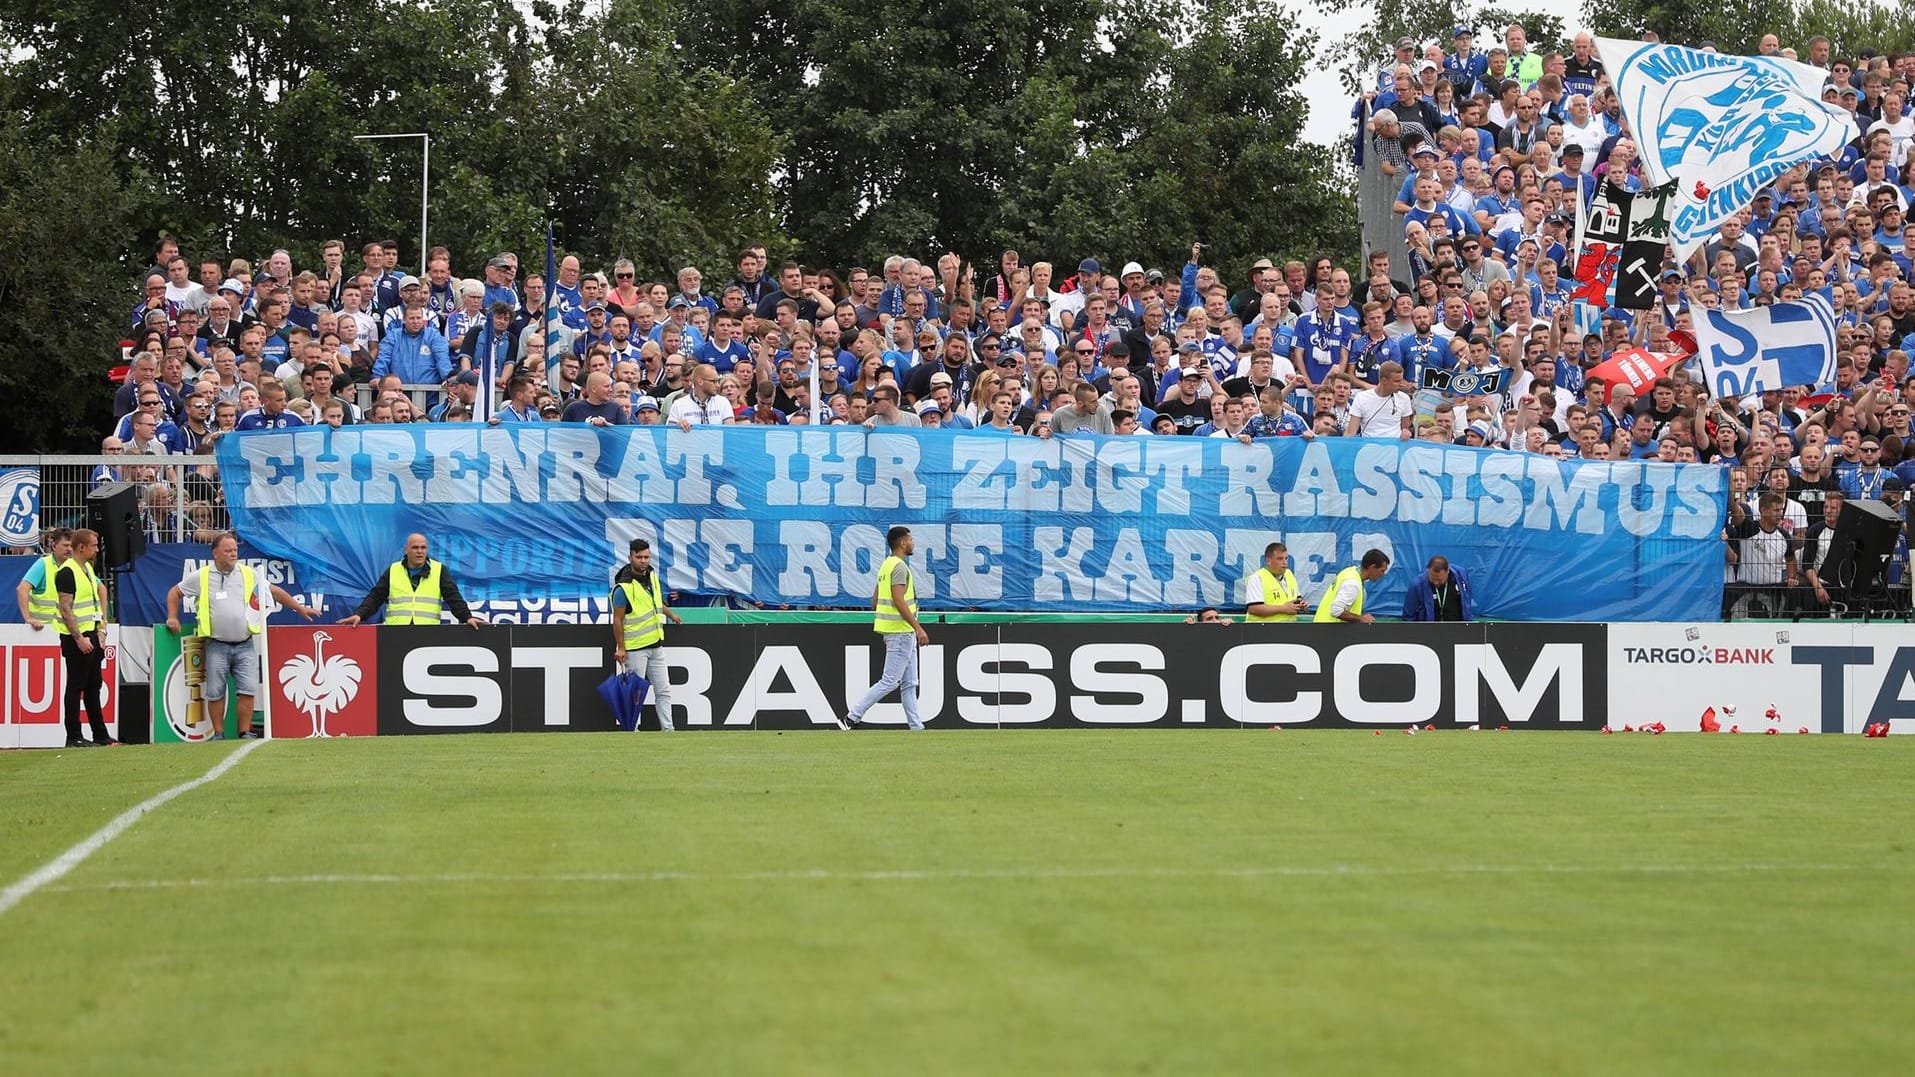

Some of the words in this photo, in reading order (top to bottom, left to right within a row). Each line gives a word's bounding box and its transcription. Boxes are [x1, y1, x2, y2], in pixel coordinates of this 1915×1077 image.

[765, 431, 926, 509] IHR
[952, 438, 1202, 516] ZEIGT
[1220, 442, 1722, 539] RASSISMUS
[402, 643, 1584, 727] STRAUSS.COM
